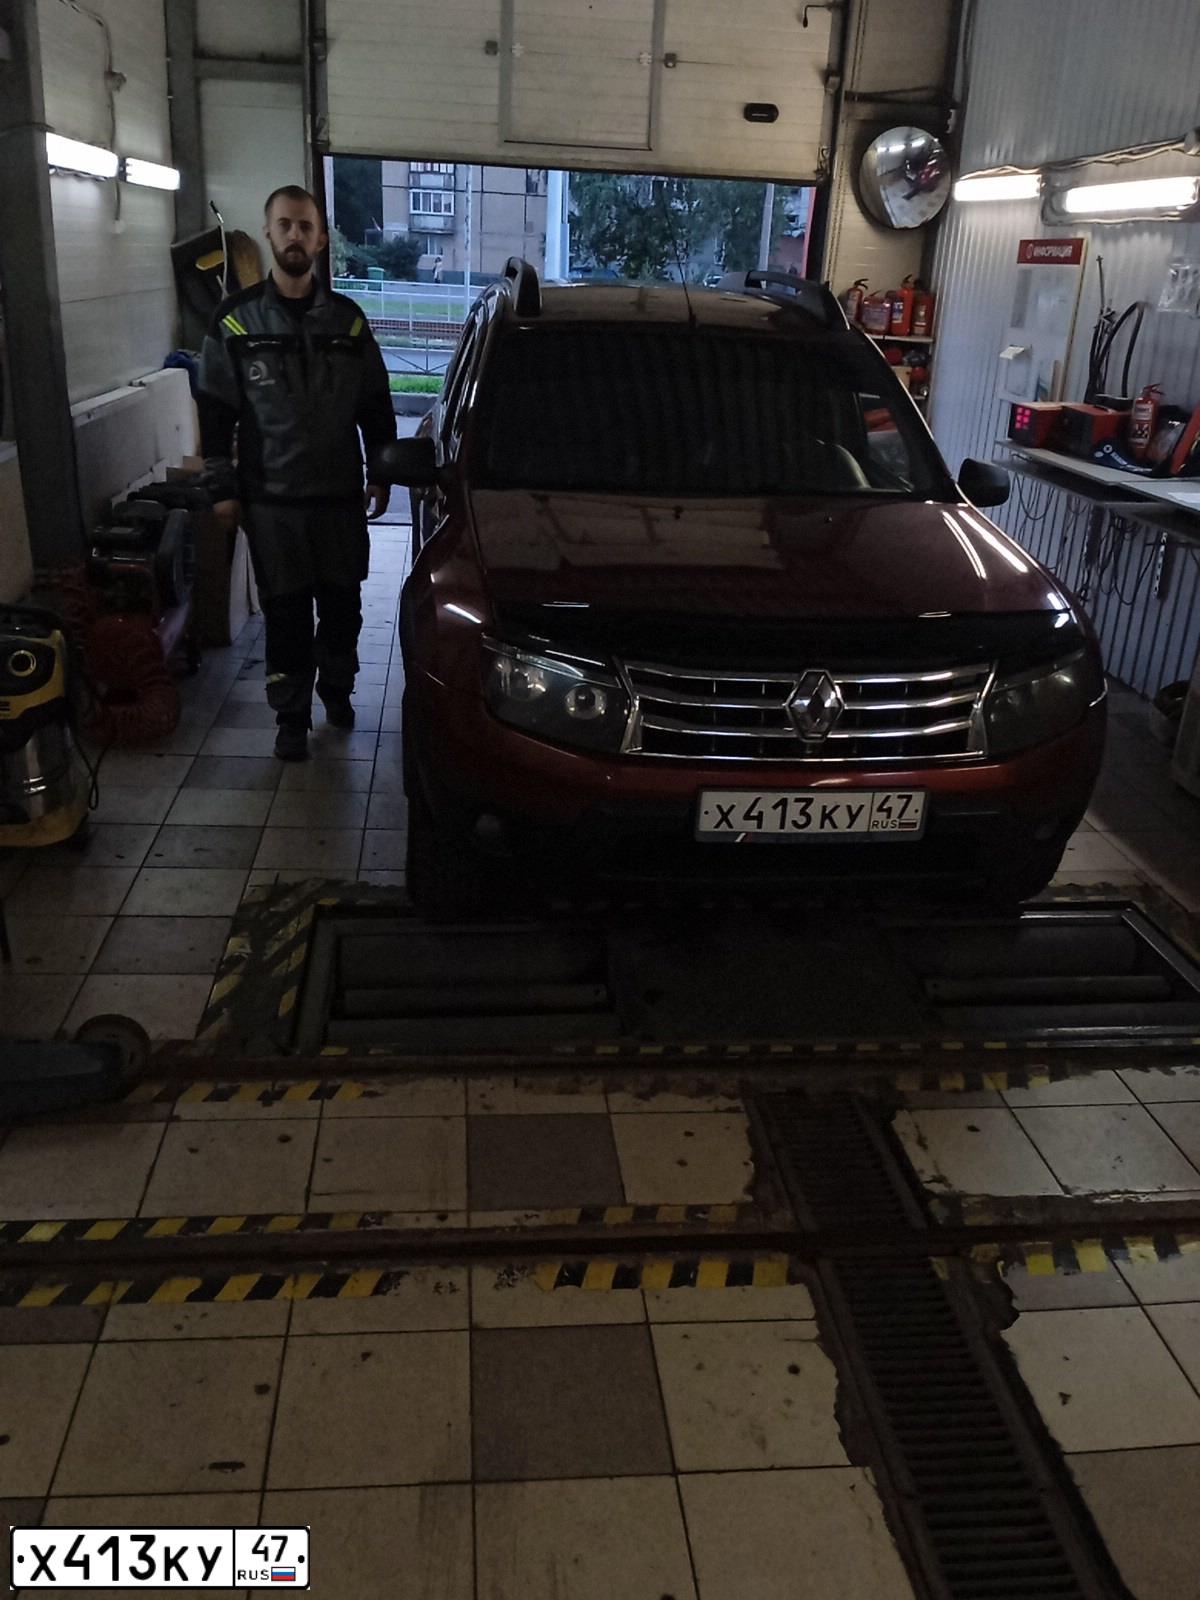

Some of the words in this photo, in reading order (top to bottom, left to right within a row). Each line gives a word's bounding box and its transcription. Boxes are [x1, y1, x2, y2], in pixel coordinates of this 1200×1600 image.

[713, 796, 865, 830] Х413КУ
[876, 794, 913, 819] 47
[871, 820, 897, 829] RUS
